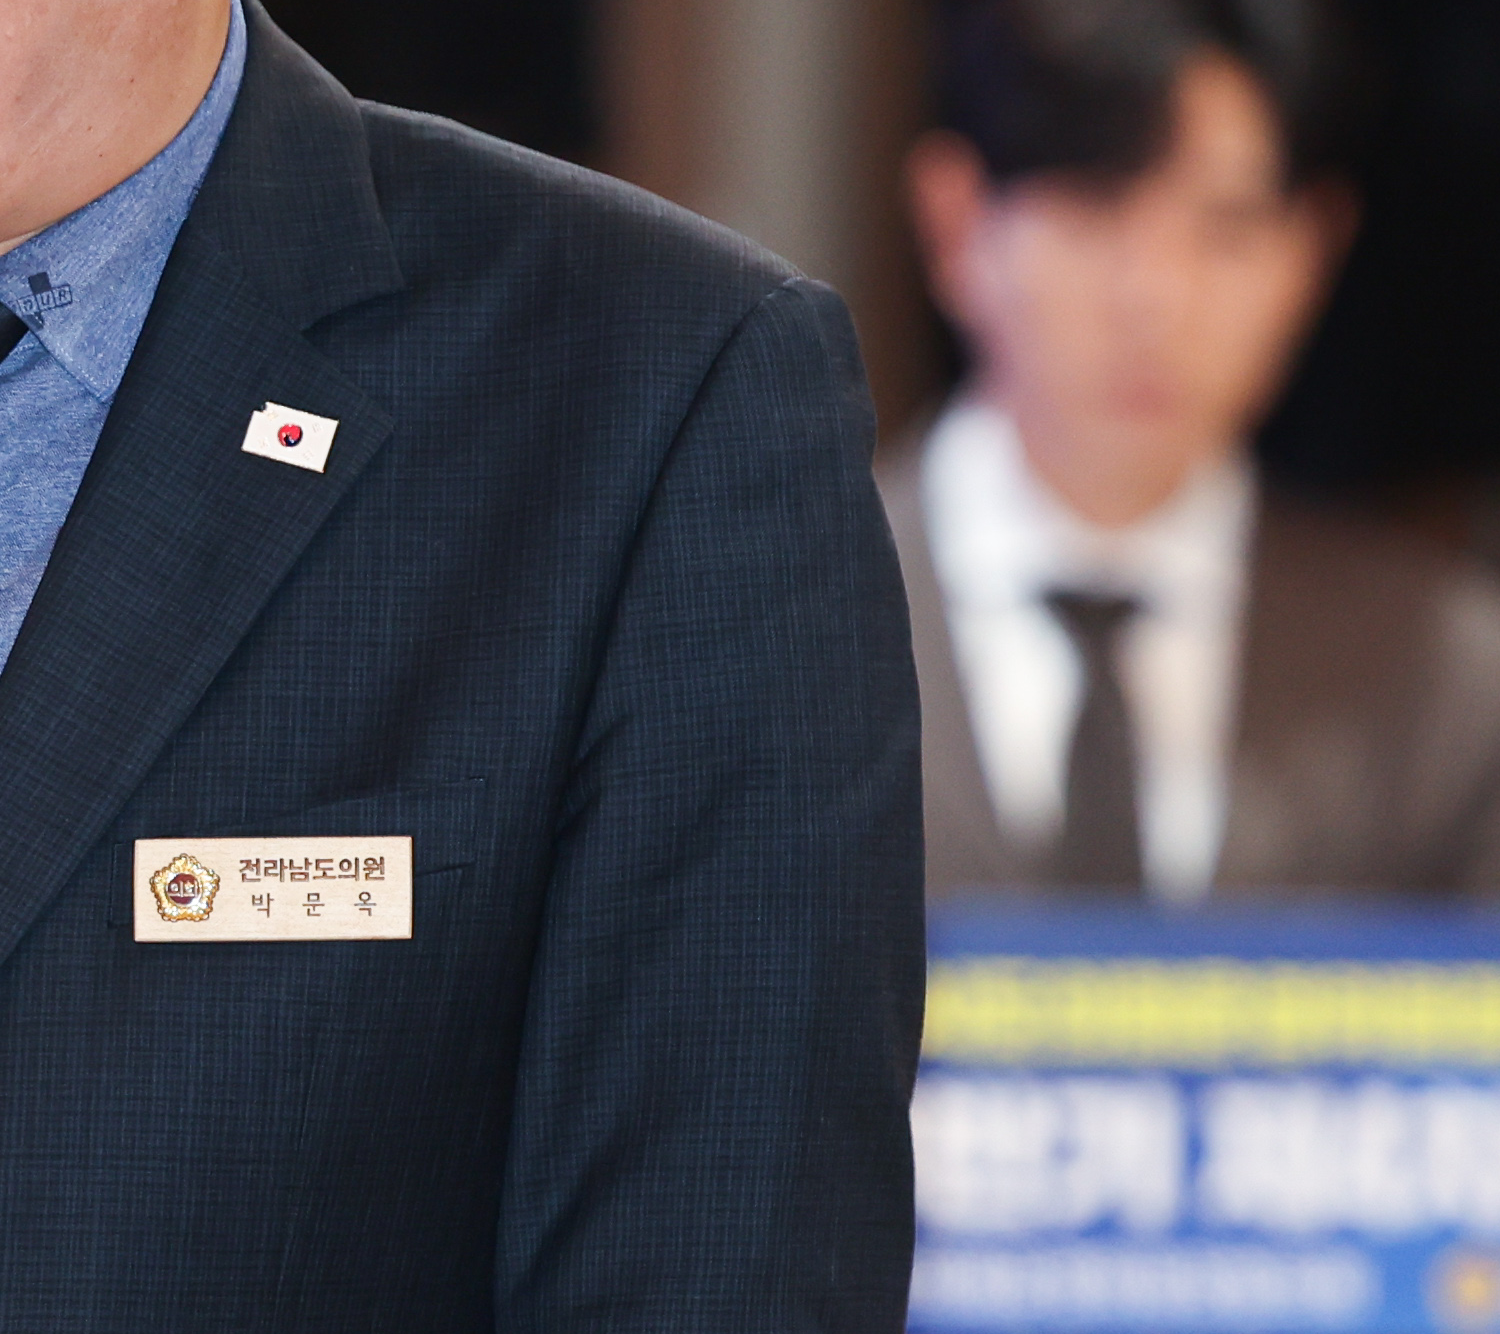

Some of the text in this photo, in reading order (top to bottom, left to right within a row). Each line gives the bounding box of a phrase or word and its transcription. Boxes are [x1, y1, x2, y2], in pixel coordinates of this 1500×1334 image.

[239, 855, 386, 883] 전라남도의원
[252, 890, 377, 918] 박 문 옥
